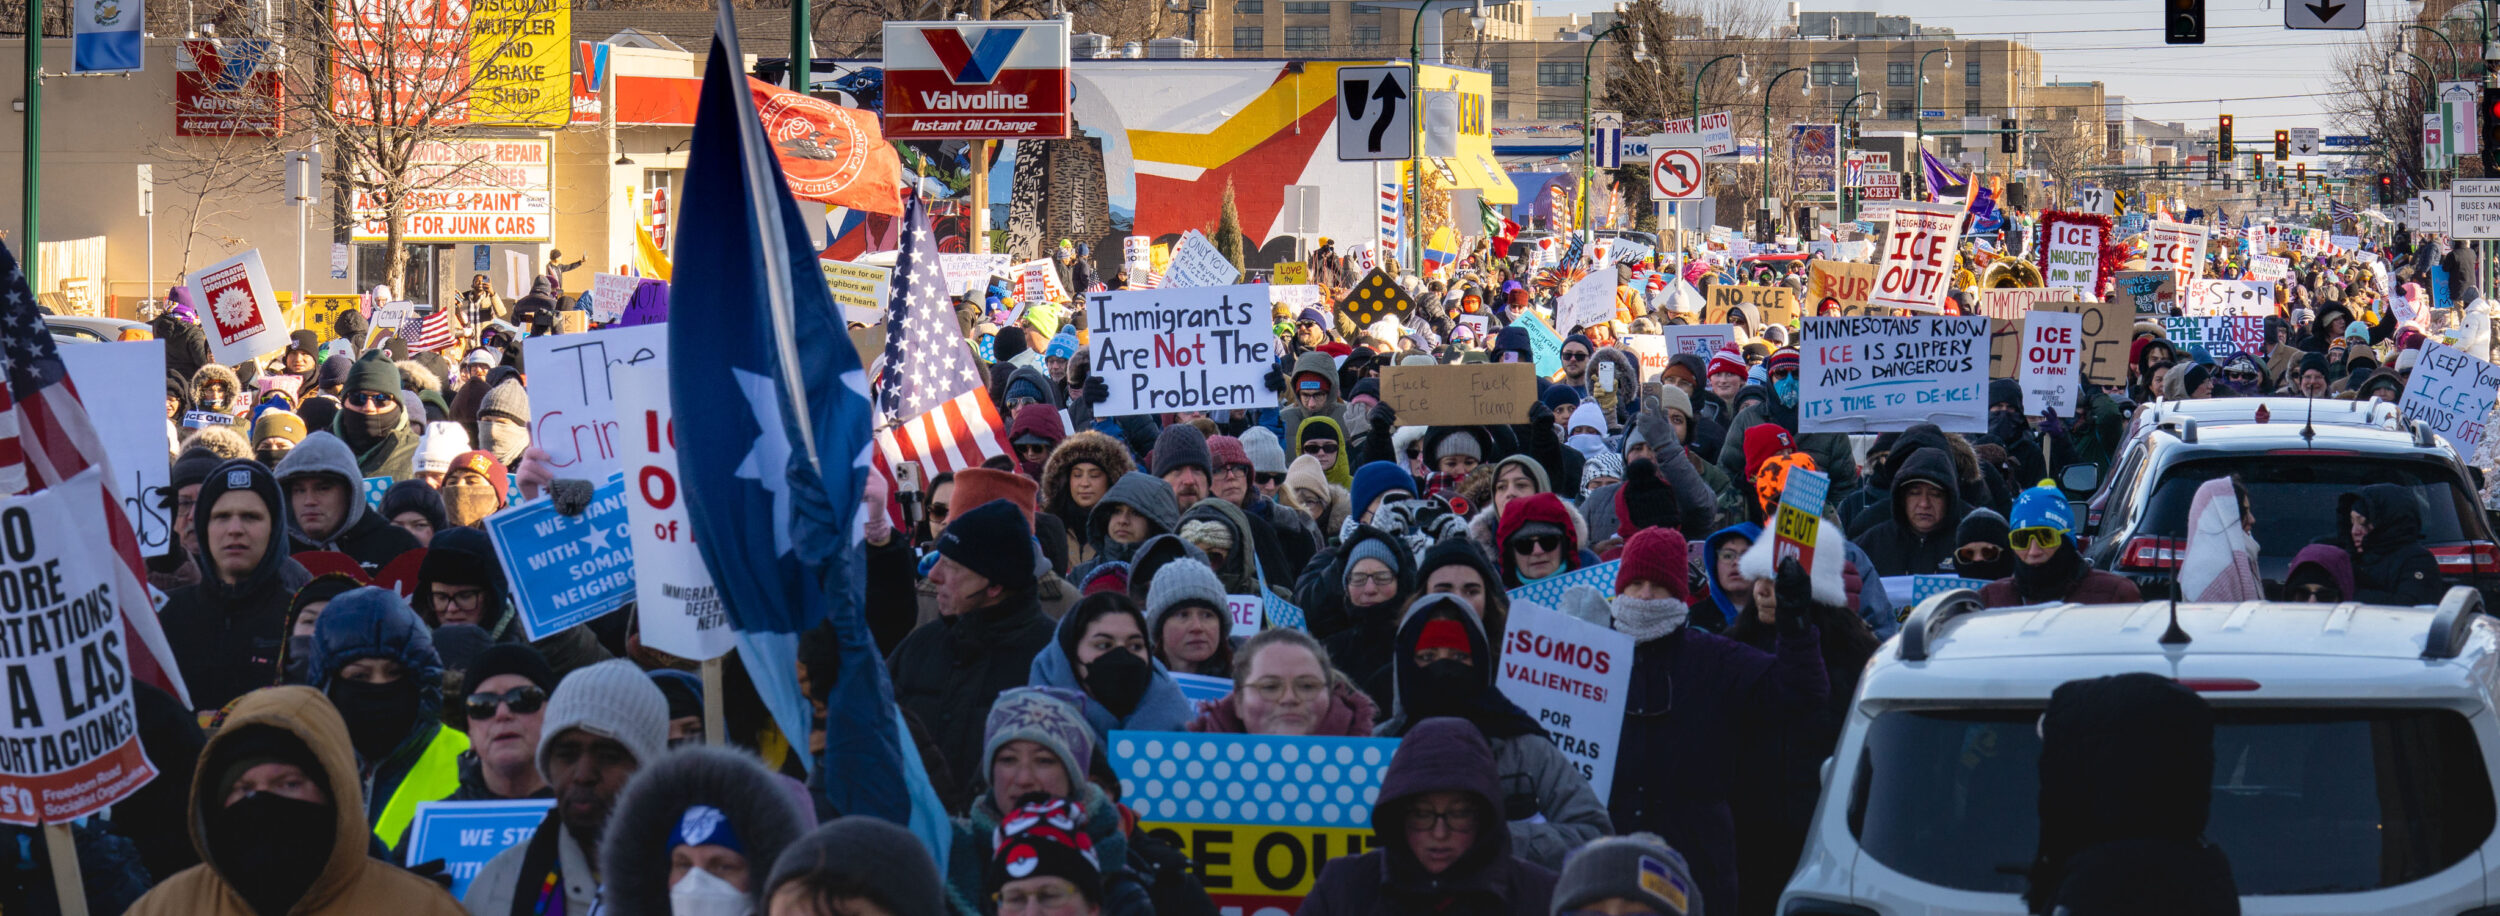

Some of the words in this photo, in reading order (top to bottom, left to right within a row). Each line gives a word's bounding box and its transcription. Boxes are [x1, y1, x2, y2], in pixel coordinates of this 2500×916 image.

[476, 19, 555, 35] MUFFLER
[500, 41, 533, 58] AND
[487, 65, 545, 81] BRAKE
[493, 87, 541, 104] SHOP
[920, 90, 1029, 110] Valvoline
[911, 119, 963, 131] Instant
[964, 119, 983, 131] Oil
[984, 119, 1038, 132] Change
[1701, 113, 1728, 131] AUTO
[496, 144, 541, 162] REPAIR
[1865, 155, 1888, 164] ATM
[487, 168, 527, 187] TIRES
[805, 179, 841, 193] CITIES
[1877, 175, 1898, 185] PARK
[2459, 185, 2482, 193] RIGHT
[404, 192, 448, 210] BODY
[456, 192, 467, 210] &
[473, 192, 522, 211] PAINT
[2460, 202, 2485, 210] BUSES
[413, 216, 442, 234] FOR
[448, 216, 490, 234] JUNK
[495, 216, 535, 234] CARS
[1895, 218, 1937, 230] NEIGHBORS
[1938, 222, 1954, 232] SAY
[2457, 214, 2479, 222] RIGHT
[1890, 231, 1947, 268] ICE
[2050, 249, 2097, 266] NAUGHTY
[2151, 242, 2195, 269] ICE
[823, 264, 838, 273] Our
[840, 268, 856, 276] love
[858, 270, 869, 278] for
[1210, 252, 1229, 276] YOU
[1280, 265, 1302, 275] Love
[202, 263, 245, 287] DEMOCRATIC
[204, 273, 248, 293] SOCIALISTS
[1882, 265, 1944, 301] OUT!
[2051, 268, 2070, 282] AND
[2074, 269, 2093, 283] NOT
[2118, 272, 2170, 288] MINNESOTA
[860, 284, 874, 293] will
[2126, 283, 2152, 297] NICE
[839, 294, 852, 303] the
[853, 296, 877, 307] hearts
[1715, 288, 1744, 306] NO
[1751, 290, 1785, 309] ICE
[1091, 294, 1253, 335] Immigrants
[2221, 316, 2263, 328] BITE
[232, 324, 266, 344] AMERICA
[1803, 317, 1921, 340] MINNESOTANS
[1931, 318, 1987, 338] KNOW
[2036, 326, 2072, 344] ICE
[2167, 328, 2202, 341] THE
[2208, 328, 2265, 342] HANDS
[1096, 336, 1149, 372] Are
[1154, 332, 1206, 368] Not
[1211, 330, 1269, 365] The
[1819, 344, 1853, 366] ICE
[1864, 342, 1885, 361] IS
[1894, 339, 1972, 360] SLIPPERY
[2029, 346, 2076, 364] OUT
[2204, 341, 2237, 356] FEED
[2236, 342, 2265, 357] YOU
[2420, 342, 2469, 377] KEEP
[1820, 366, 1862, 387] AND
[1872, 357, 1973, 379] DANGEROUS
[2032, 366, 2044, 375] of
[2047, 366, 2067, 376] MN!
[1131, 369, 1255, 410] Problem
[1392, 374, 1430, 393] Fuck
[1471, 373, 1512, 393] Fuck
[1394, 396, 1429, 413] Ice
[1470, 394, 1514, 419] Trump
[1805, 399, 1833, 419] IT'S
[1840, 394, 1877, 412] TIME
[1884, 392, 1906, 406] TO
[186, 413, 205, 421] ICE
[2404, 398, 2454, 433] HANDS
[2456, 419, 2485, 445] OFF
[534, 515, 566, 538] WE
[1794, 514, 1816, 543] OUT
[527, 540, 580, 572] WITH
[1505, 629, 1611, 675] ¡SOMOS
[6, 664, 44, 729] A
[53, 629, 126, 722] LAS
[1505, 662, 1609, 704] VALIENTES!
[1540, 708, 1572, 729] POR
[42, 780, 97, 802] Freedom
[44, 792, 97, 817] Socialist
[460, 828, 494, 847] WE
